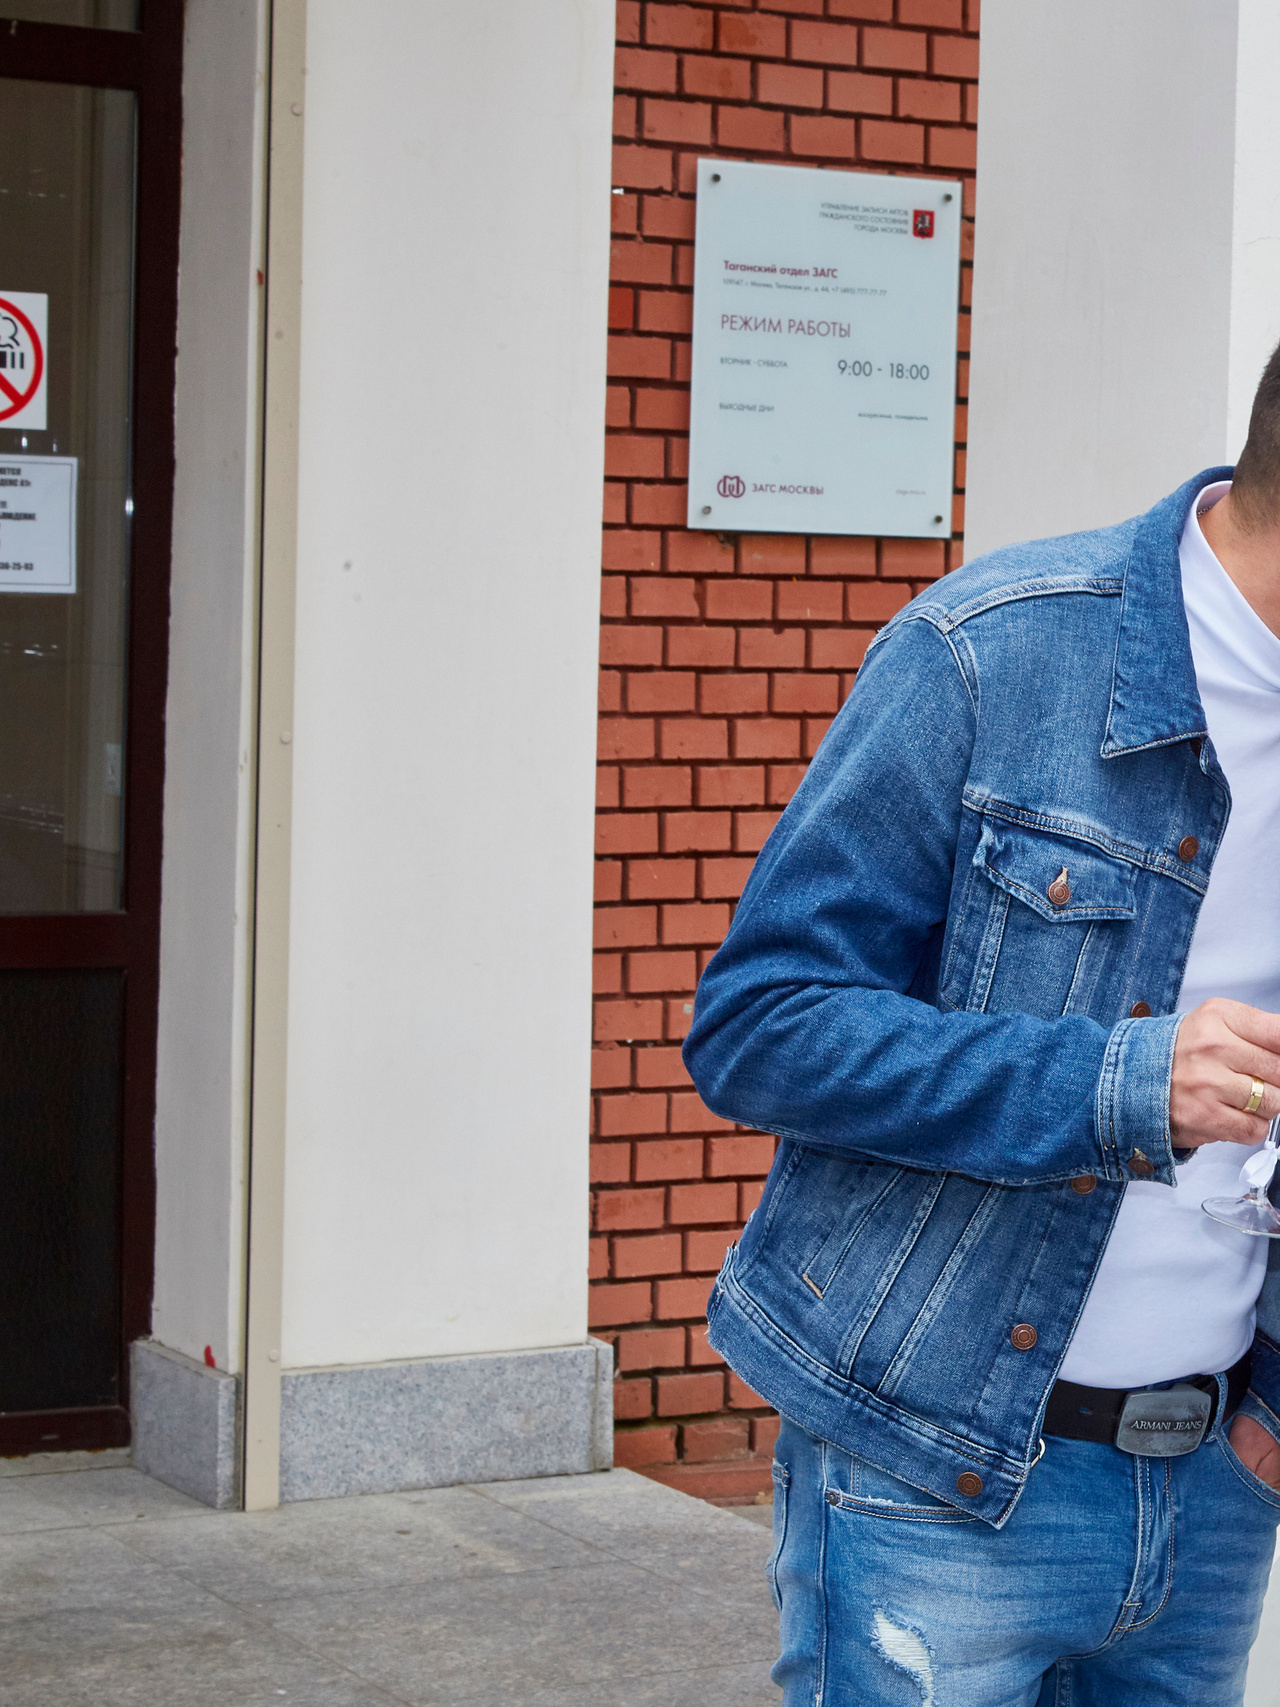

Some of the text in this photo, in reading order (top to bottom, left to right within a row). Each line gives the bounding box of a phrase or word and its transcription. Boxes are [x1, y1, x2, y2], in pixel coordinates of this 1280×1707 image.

[723, 260, 838, 279] Таганский отдел ЗАГС
[721, 314, 851, 338] РЕЖИМ РАБОТЫ
[837, 359, 873, 377] 9:00
[889, 363, 930, 381] 18:00
[752, 483, 824, 495] ЗАГС МОСКВЫ
[1131, 1420, 1202, 1431] ARMANI JEANS
